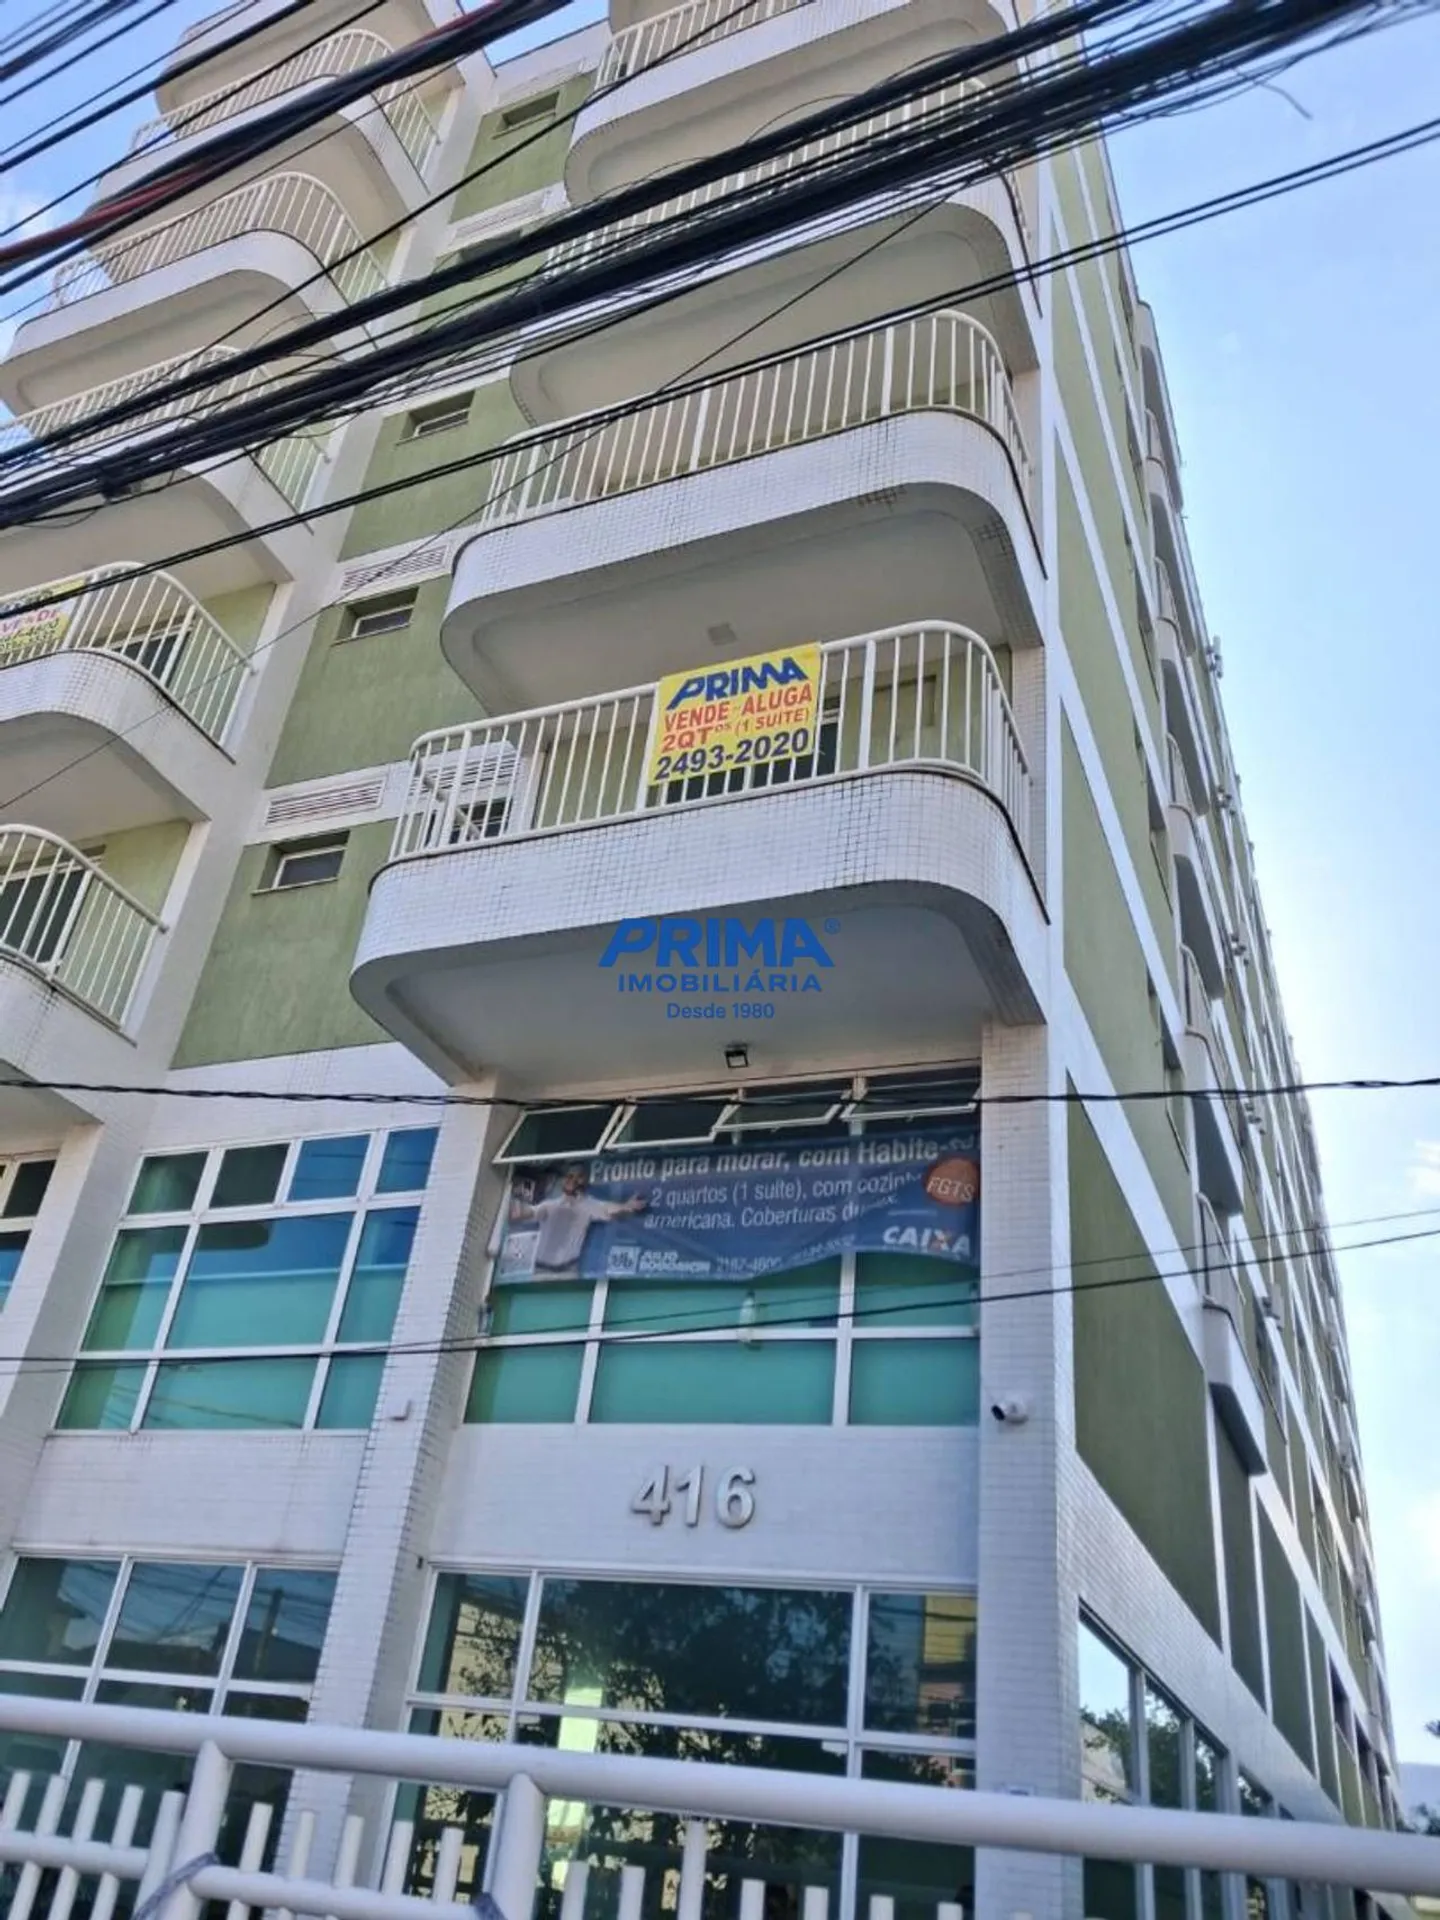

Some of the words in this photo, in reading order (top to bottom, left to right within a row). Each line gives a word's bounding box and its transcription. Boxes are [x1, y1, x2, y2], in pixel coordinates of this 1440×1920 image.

[666, 656, 809, 711] PRIMA
[664, 700, 731, 733] VENDE
[741, 682, 813, 716] ALUGA
[655, 728, 810, 782] 2493-2020
[589, 1156, 655, 1184] Pronto
[661, 1153, 711, 1183] para
[716, 1149, 789, 1173] morar,
[798, 1146, 851, 1168] com
[650, 1186, 662, 1208] 2
[666, 1185, 728, 1211] quartos
[733, 1179, 748, 1208] (1
[813, 1179, 852, 1199] com
[926, 1175, 975, 1203] FGTS
[643, 1206, 736, 1230] americana.
[741, 1201, 837, 1228] Coberturas
[882, 1225, 971, 1257] CAIXA
[630, 1463, 756, 1529] 416
